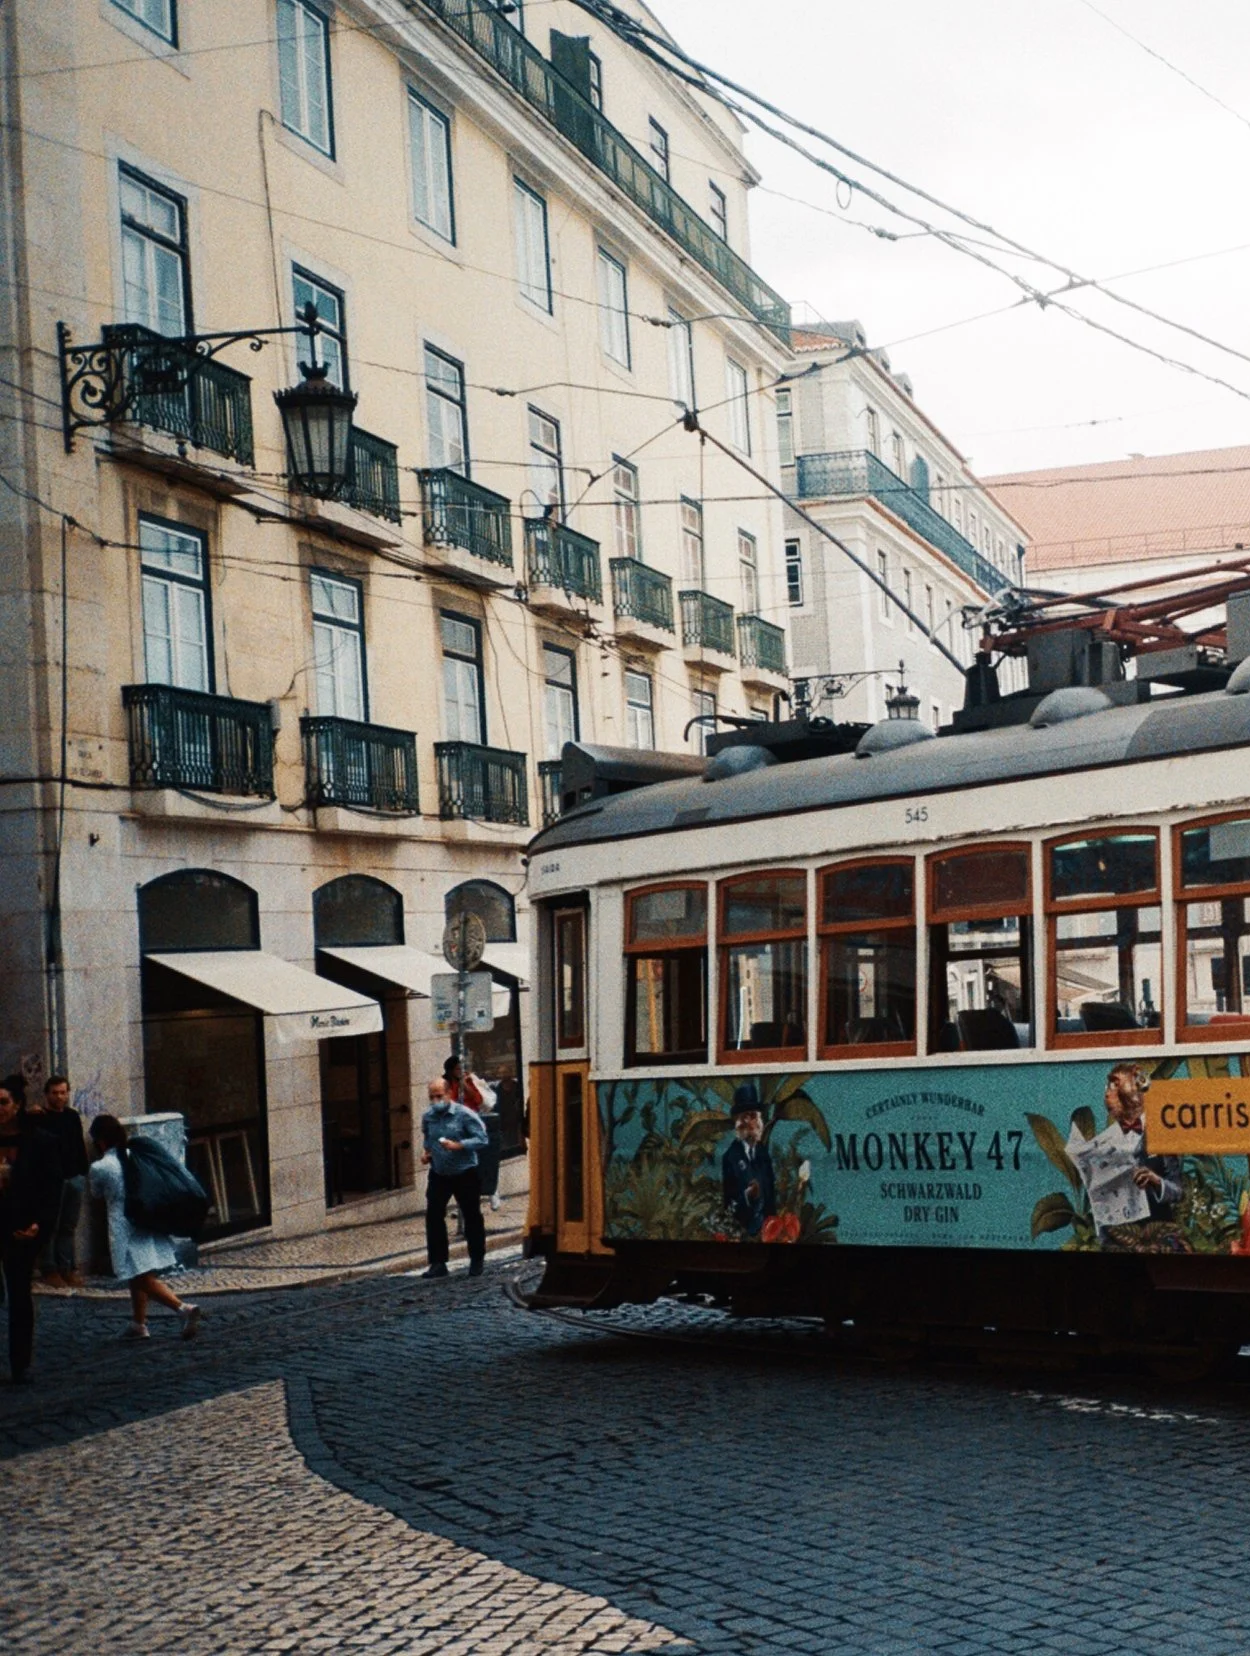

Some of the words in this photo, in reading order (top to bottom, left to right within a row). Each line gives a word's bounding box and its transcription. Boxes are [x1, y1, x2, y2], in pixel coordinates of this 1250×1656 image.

[905, 806, 929, 824] 545
[866, 1093, 918, 1119] CERTAINLY
[919, 1092, 985, 1117] WUNDERBAR
[1160, 1092, 1249, 1129] carris
[835, 1131, 977, 1171] MONKEY
[986, 1130, 1024, 1170] 47
[880, 1182, 983, 1201] SCHWARZWALD
[904, 1206, 930, 1224] DRY
[935, 1206, 960, 1223] GIN
